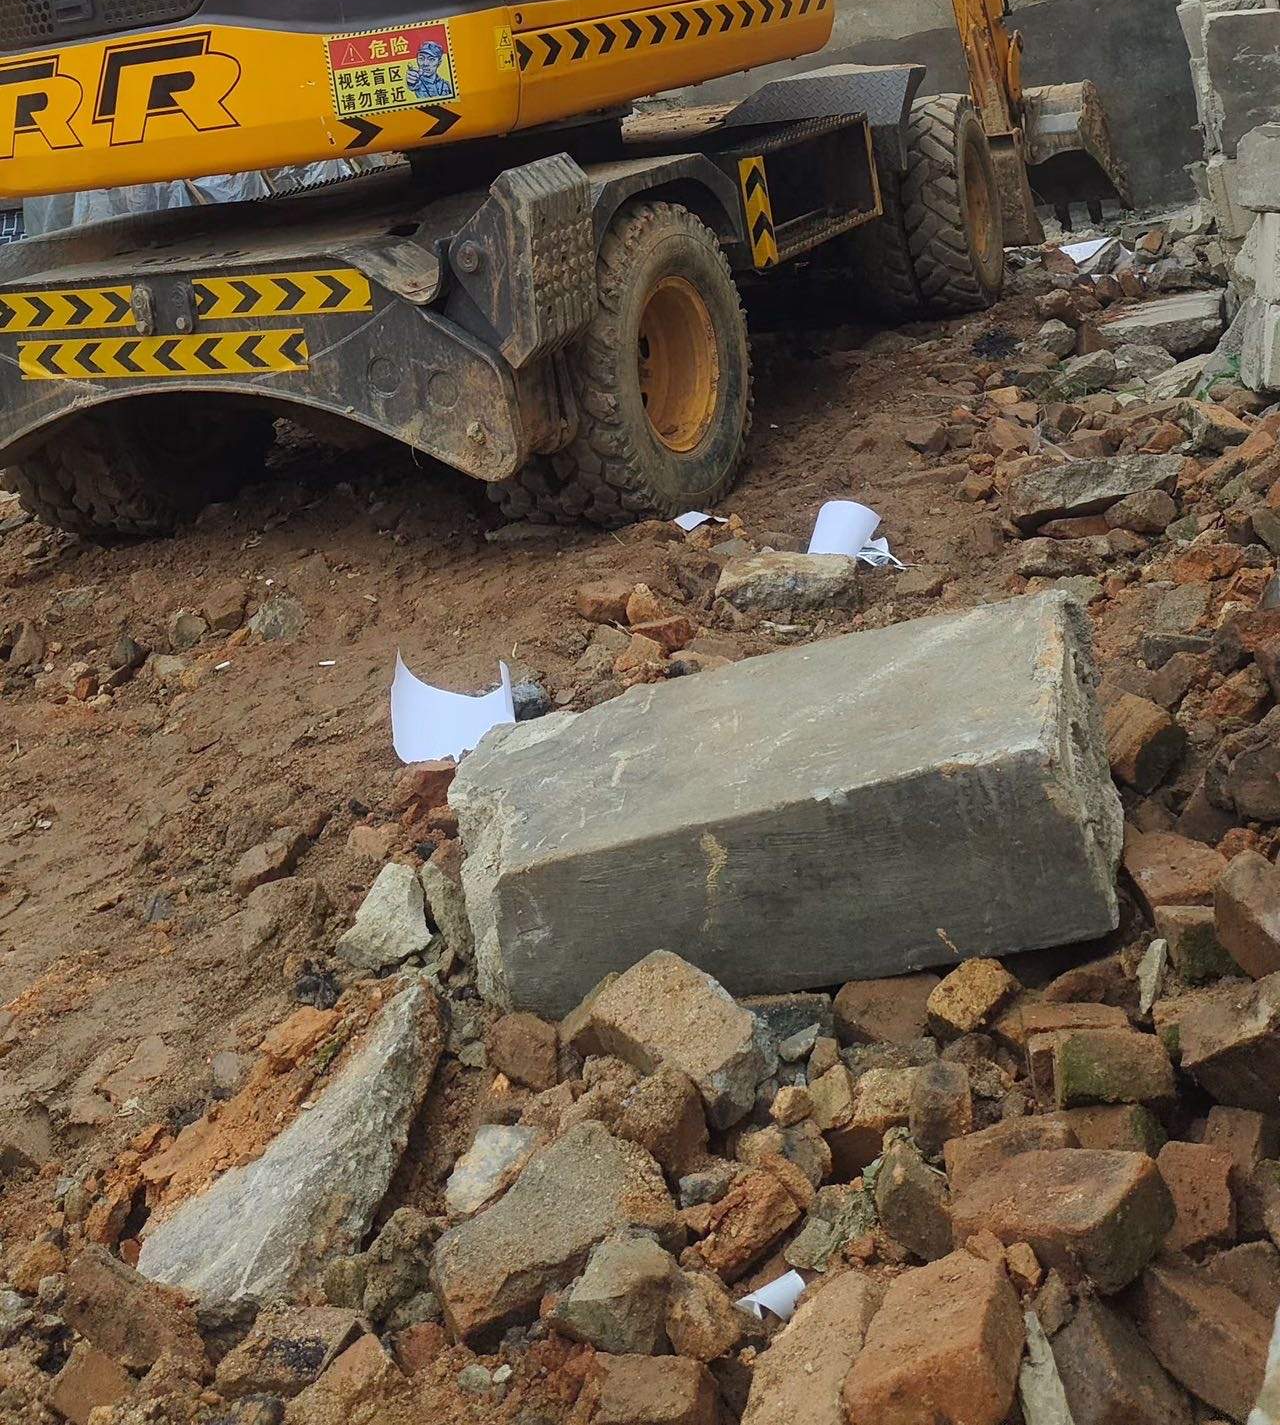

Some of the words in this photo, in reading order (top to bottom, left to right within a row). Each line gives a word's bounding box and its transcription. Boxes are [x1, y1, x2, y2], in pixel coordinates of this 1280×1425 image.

[368, 36, 410, 60] 危险
[338, 65, 403, 91] 视线盲区
[341, 86, 407, 112] 请勿靠近
